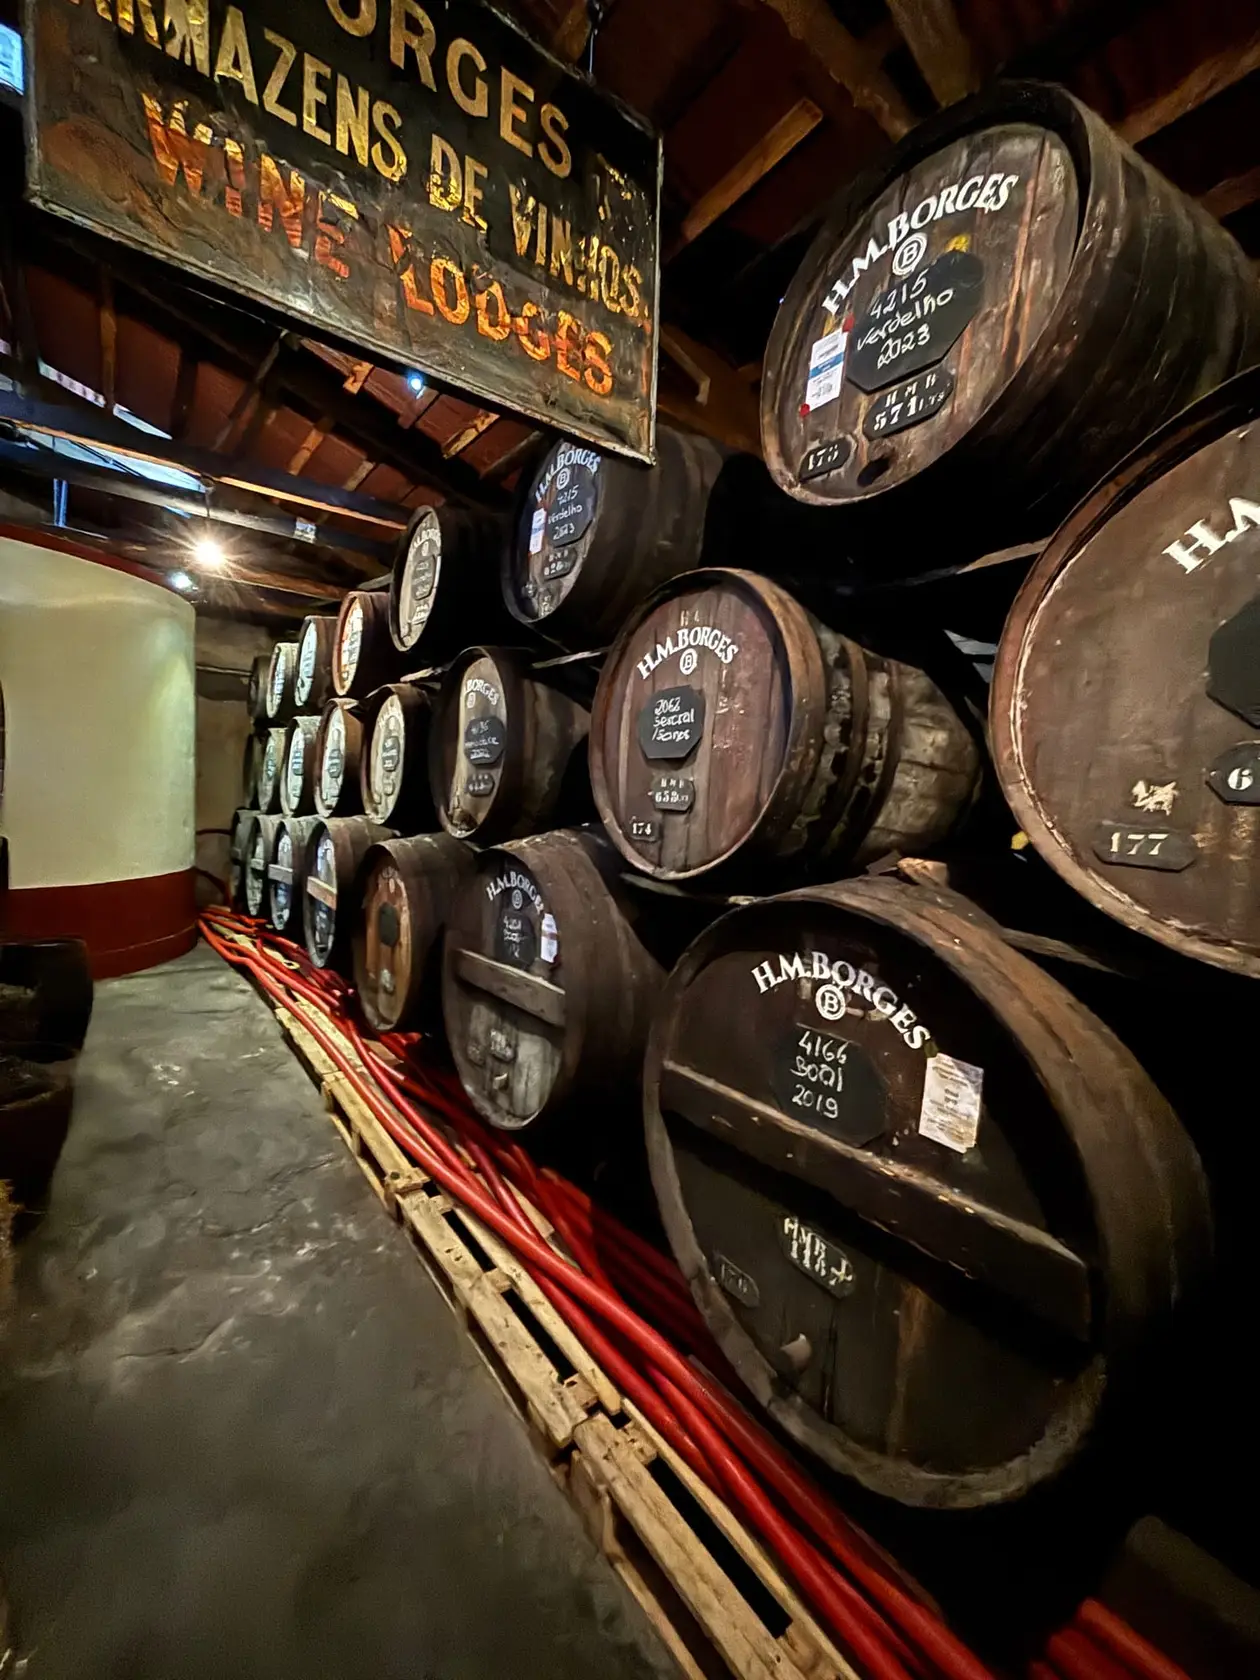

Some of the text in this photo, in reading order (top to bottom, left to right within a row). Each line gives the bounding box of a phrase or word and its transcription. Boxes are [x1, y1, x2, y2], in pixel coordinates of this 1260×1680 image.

[68, 0, 408, 182] RMAZENS
[427, 132, 489, 235] DE
[869, 267, 930, 320] 4215
[876, 323, 932, 370] 2023
[1109, 831, 1169, 856] 177
[791, 1083, 839, 1120] 2019
